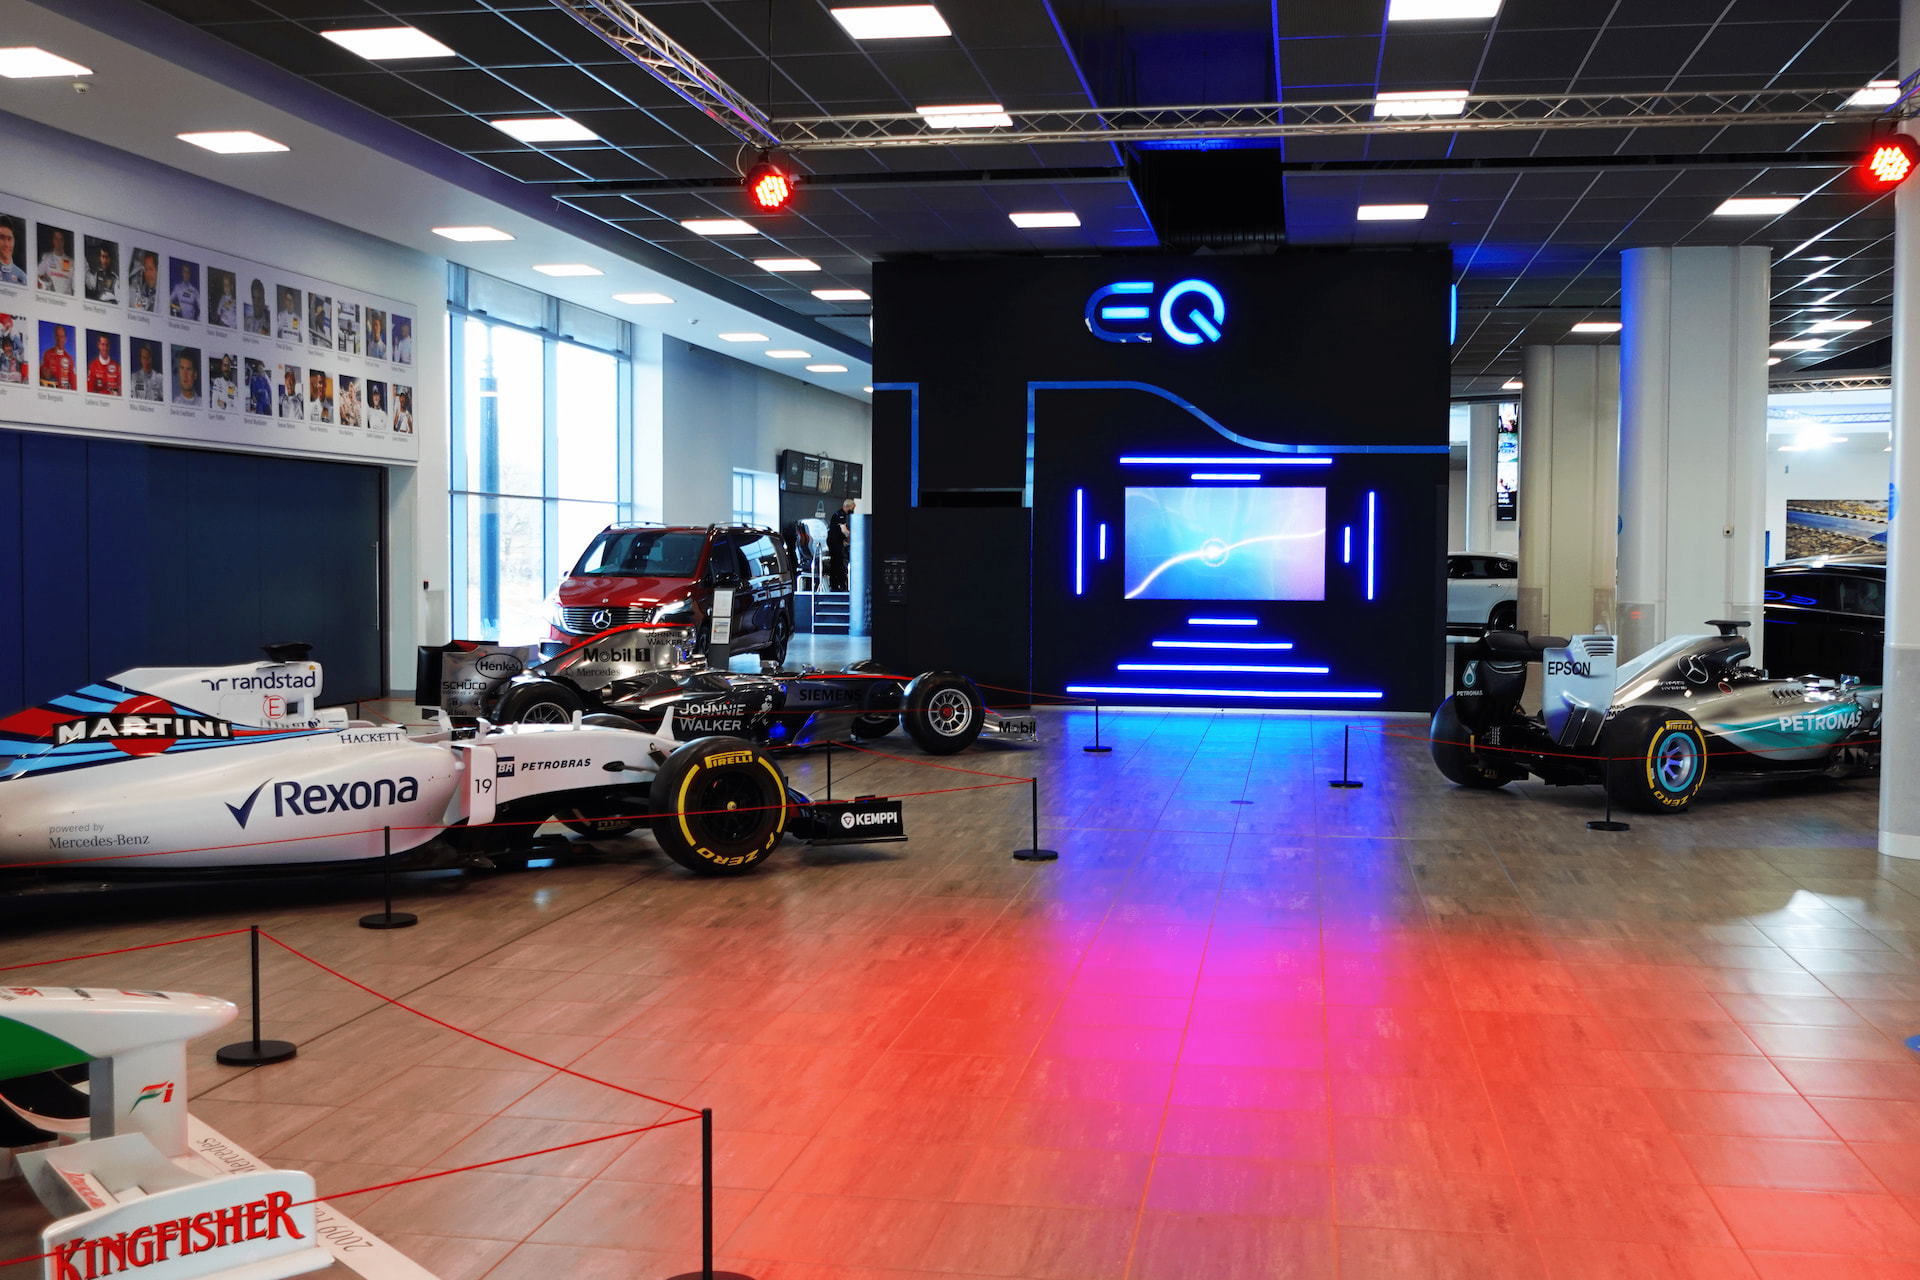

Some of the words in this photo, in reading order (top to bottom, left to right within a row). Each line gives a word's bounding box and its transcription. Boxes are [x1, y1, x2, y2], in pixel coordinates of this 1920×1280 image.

[1085, 279, 1225, 345] EQ
[647, 638, 683, 646] WALKER
[583, 648, 631, 662] Mobil
[1548, 661, 1591, 676] EPSON
[232, 671, 316, 690] randstad
[443, 678, 487, 690] SCHÜCO
[800, 689, 863, 702] SIEMENS
[680, 703, 746, 716] JOHNNIE
[680, 719, 742, 731] WALKER
[999, 721, 1036, 734] Mobil
[1665, 720, 1693, 731] PIRELLI
[1778, 710, 1862, 732] PETRONAS
[58, 715, 230, 745] MARTINI
[341, 732, 401, 745] HACKETT
[521, 758, 592, 772] PETROBRAS
[704, 750, 753, 770] PIRELLI
[475, 778, 493, 794] 19
[274, 776, 419, 818] Rexona
[855, 811, 898, 825] KEMPPI
[49, 823, 90, 835] powered
[93, 823, 105, 834] by
[49, 834, 151, 849] Mercedes-Benz
[696, 847, 760, 867] ZERO
[54, 1190, 306, 1280] KINGFISHER
[317, 1225, 374, 1252] 2009
